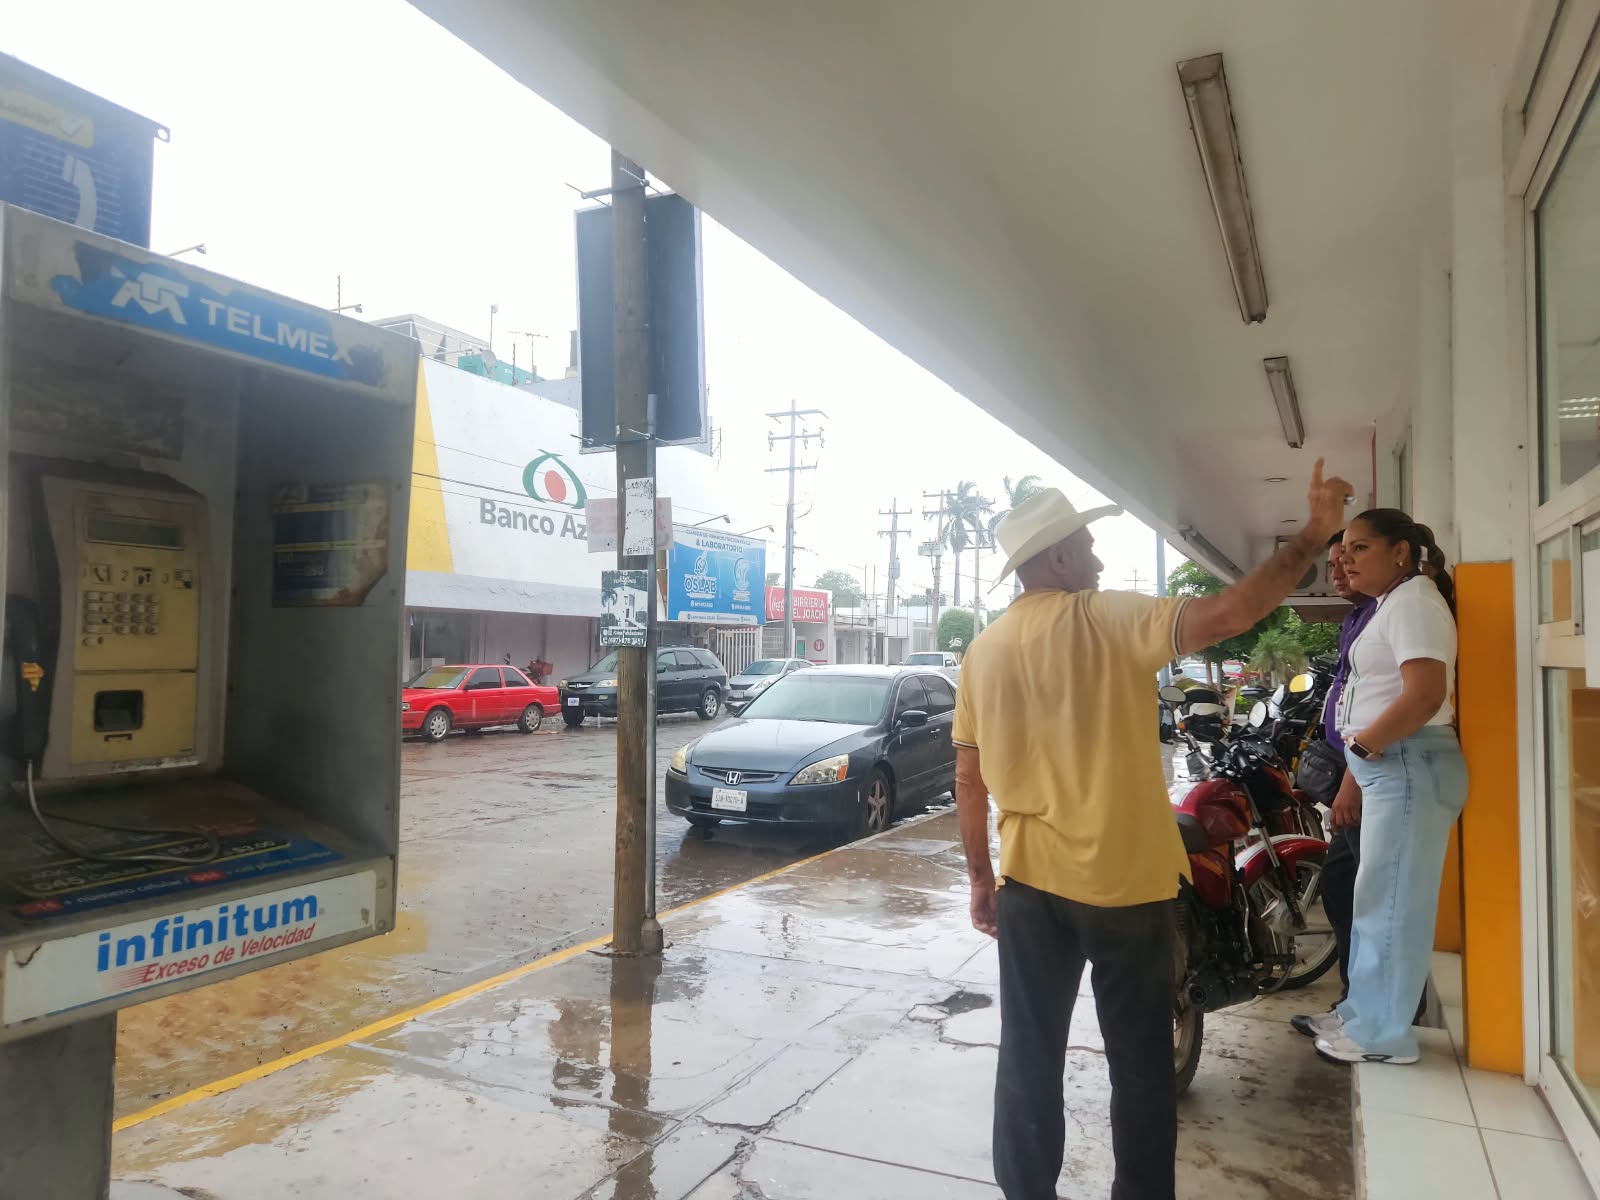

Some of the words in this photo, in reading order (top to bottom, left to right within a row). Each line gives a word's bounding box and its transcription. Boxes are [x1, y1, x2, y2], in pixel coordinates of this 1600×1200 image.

[200, 298, 353, 366] TELMEX
[480, 497, 555, 536] Banco
[701, 540, 743, 553] LABORATORIO
[685, 577, 716, 593] OSLAB
[792, 608, 801, 618] EL
[97, 894, 318, 972] infinitum
[143, 953, 209, 984] Exceso
[213, 946, 235, 964] de
[241, 923, 316, 957] Velocidad
